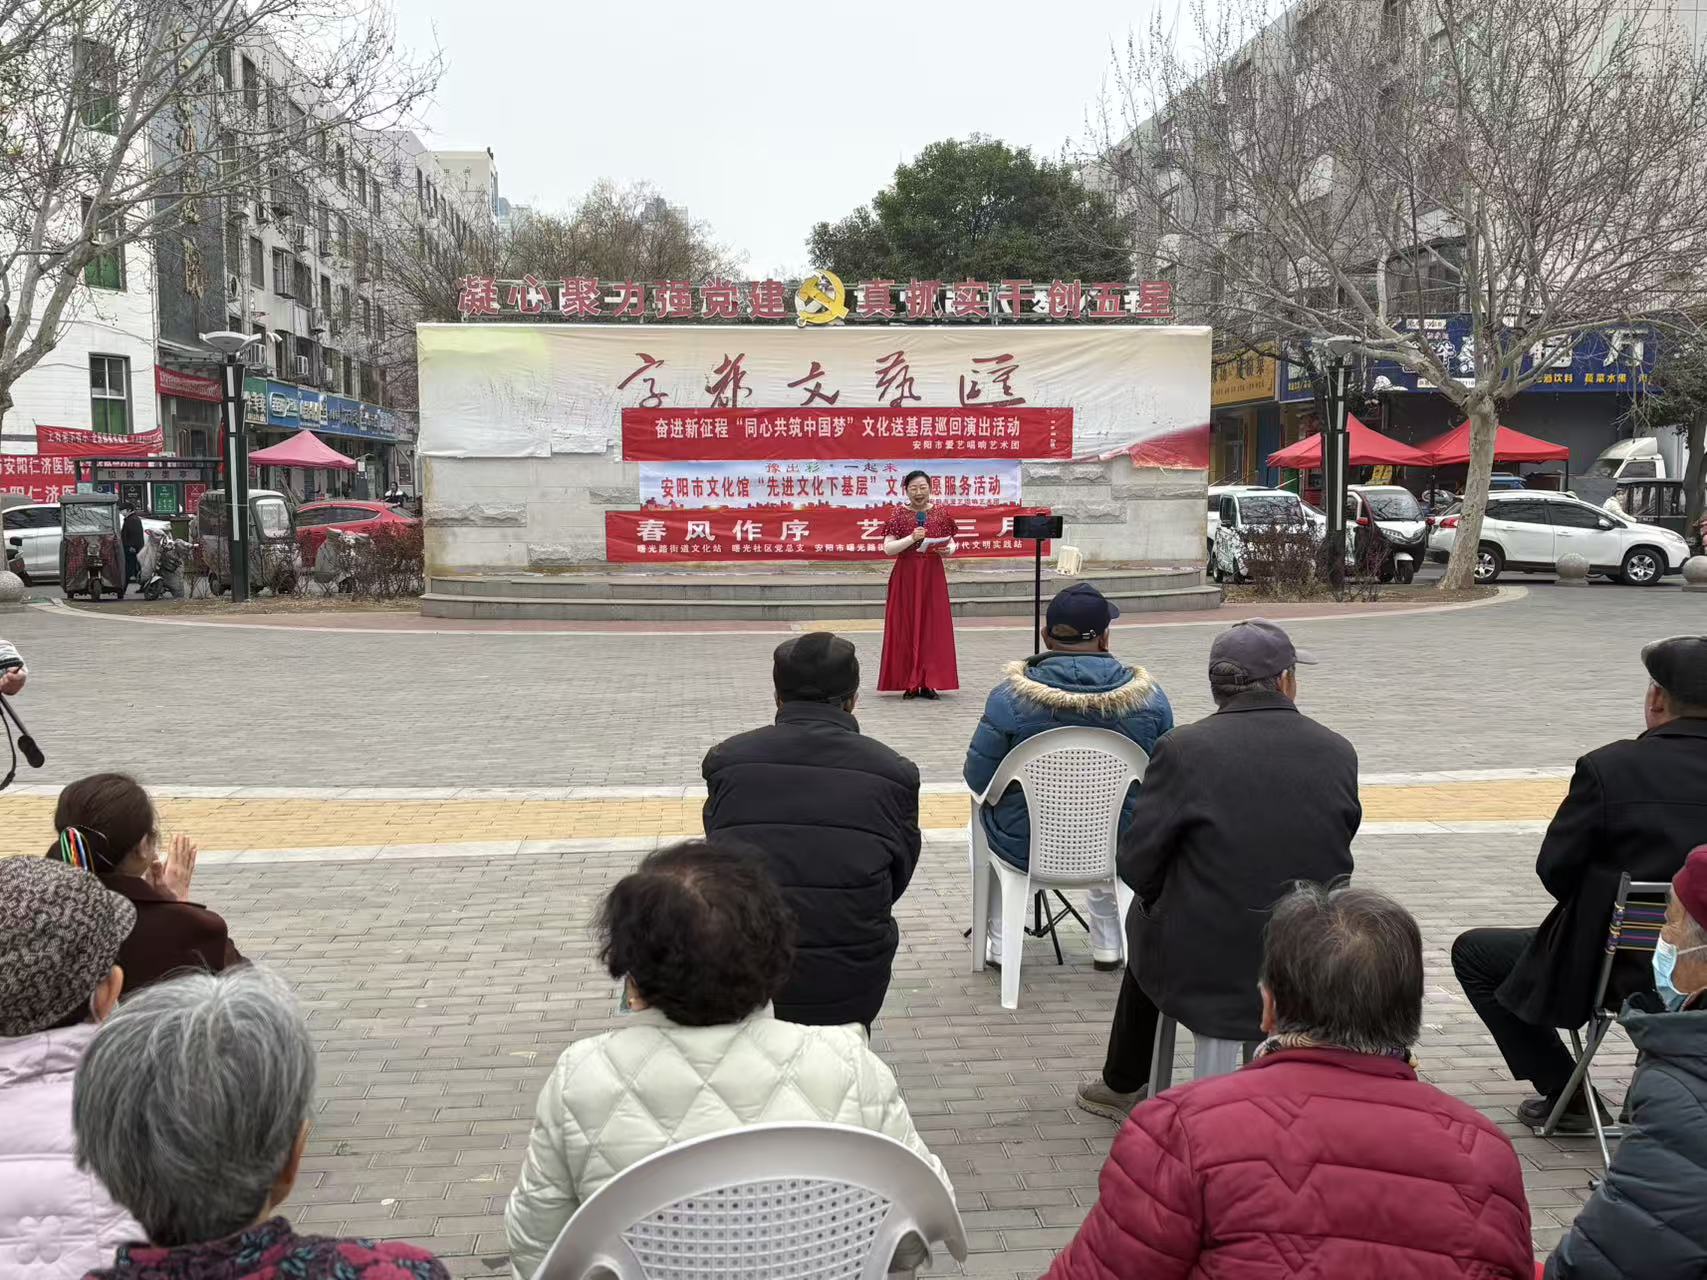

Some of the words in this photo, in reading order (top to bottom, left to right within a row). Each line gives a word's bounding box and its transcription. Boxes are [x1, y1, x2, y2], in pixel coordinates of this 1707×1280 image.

[458, 275, 788, 319] 凝心聚力强党建
[857, 277, 1173, 319] 真抓实干创五星
[0, 456, 75, 475] 安阳仁济医院
[636, 519, 810, 542] 春风作序
[636, 544, 722, 553] 曙光路街道文化站
[731, 544, 805, 553] 曙光社区党总支
